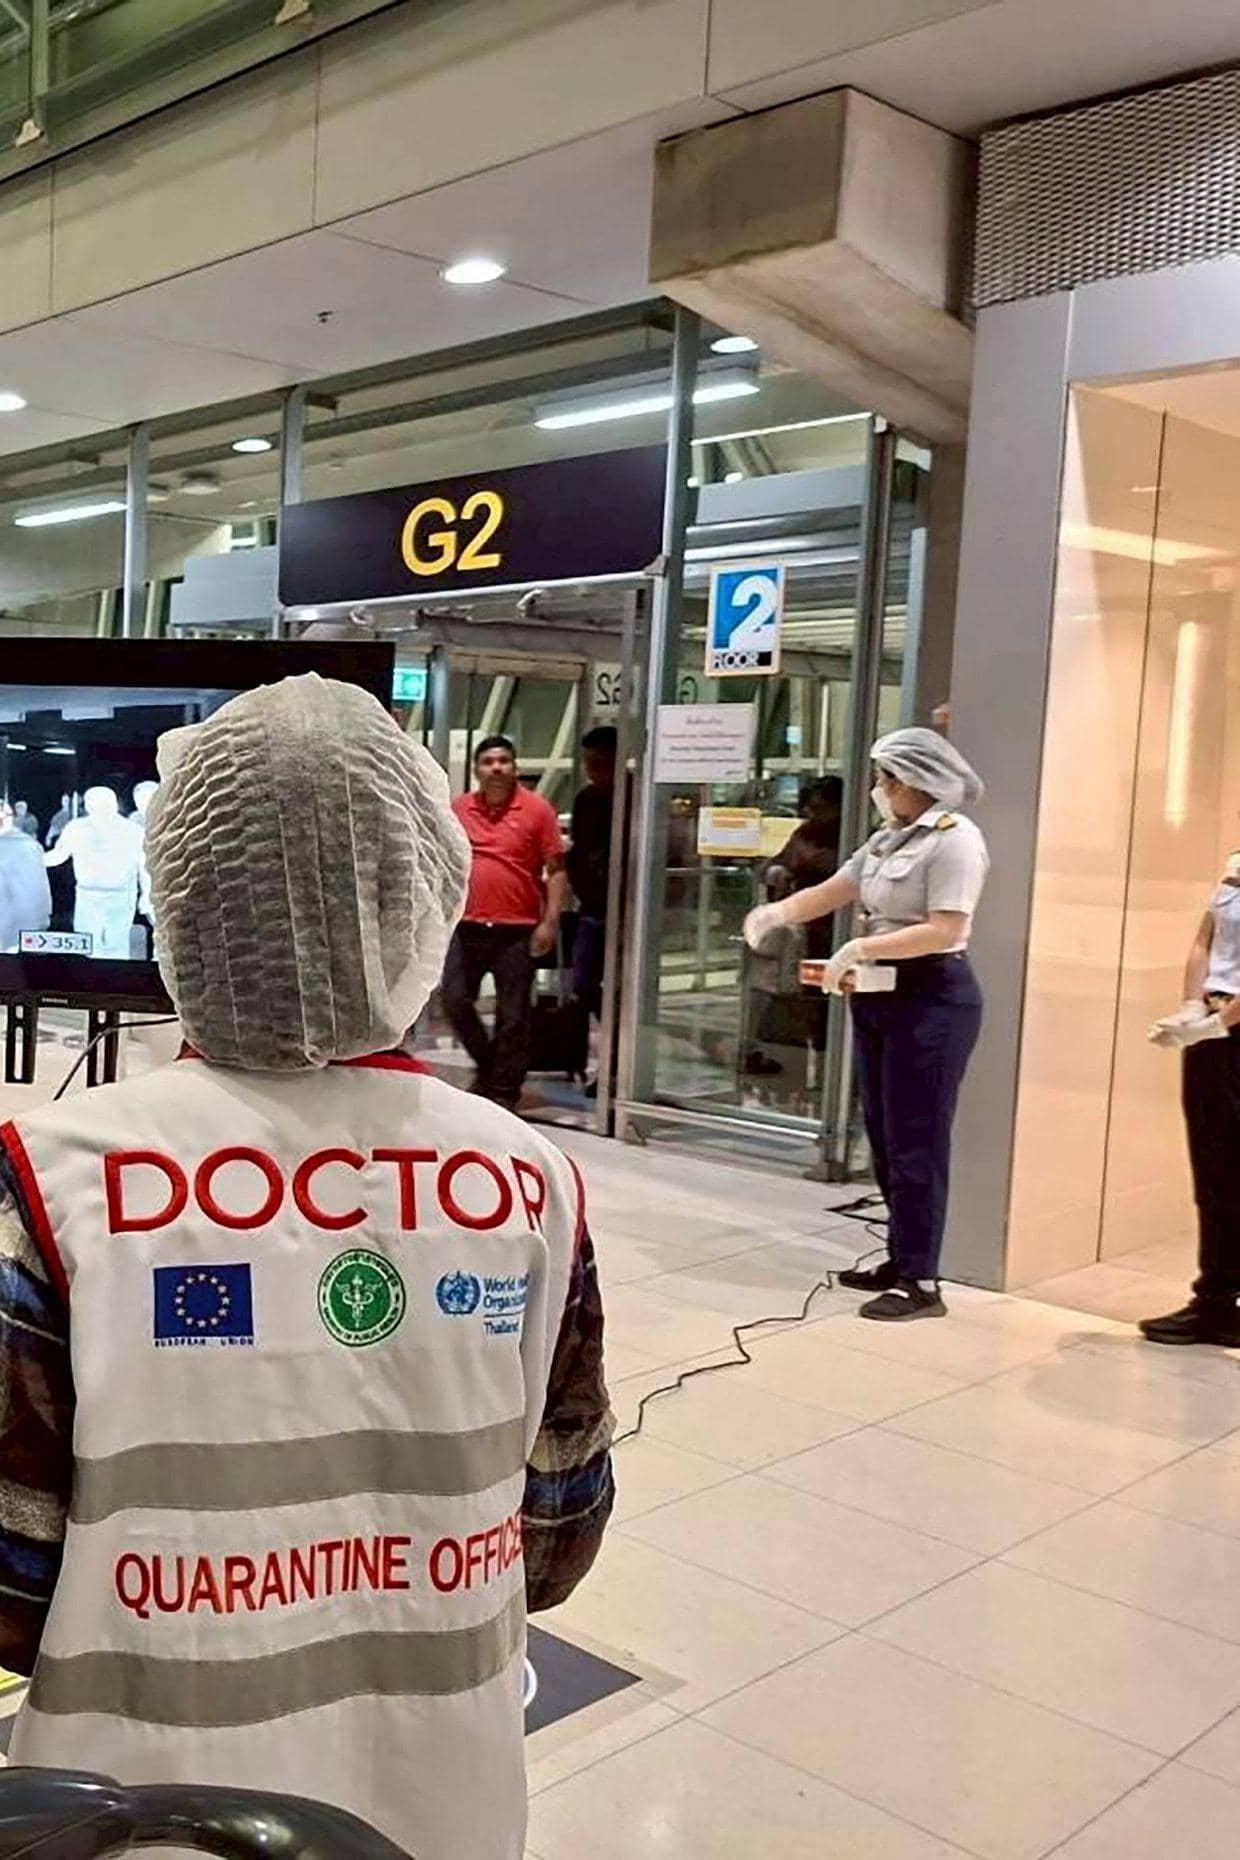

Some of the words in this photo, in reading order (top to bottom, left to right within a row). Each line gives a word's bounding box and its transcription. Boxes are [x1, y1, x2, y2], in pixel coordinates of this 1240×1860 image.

[401, 490, 504, 576] G2
[728, 575, 778, 651] 2
[52, 937, 89, 950] 35.1
[104, 1146, 546, 1234] DOCTOR
[115, 1536, 411, 1619] QUARANTINE
